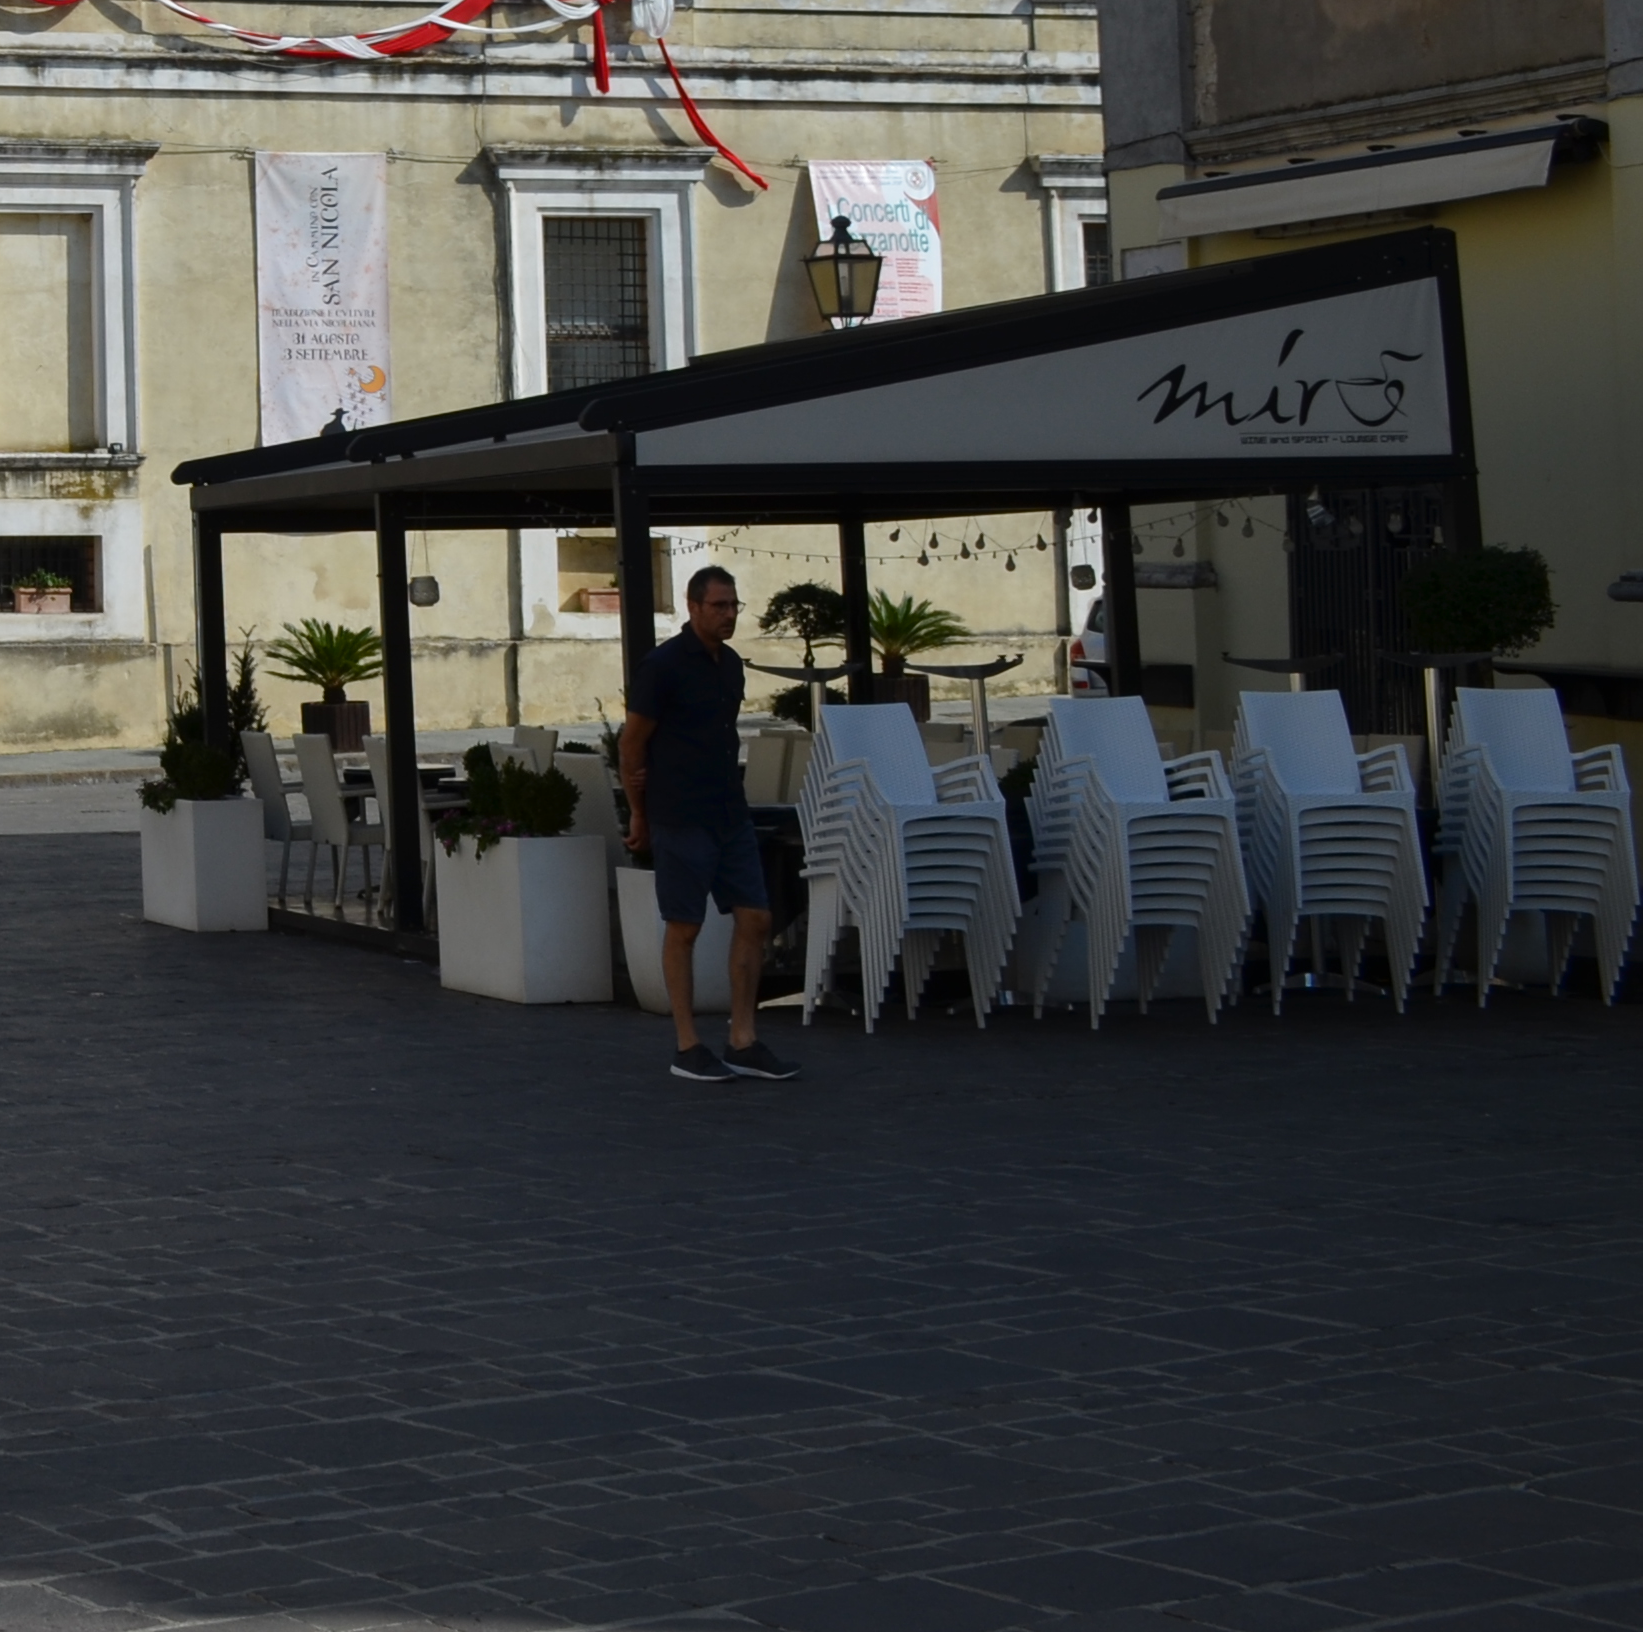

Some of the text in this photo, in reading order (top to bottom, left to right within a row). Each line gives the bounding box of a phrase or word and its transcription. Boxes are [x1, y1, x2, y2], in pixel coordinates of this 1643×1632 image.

[837, 197, 911, 223] Concerti
[915, 206, 930, 231] di
[320, 166, 341, 305] SAN NICOLA
[849, 229, 930, 253] ezzanotte
[311, 272, 320, 283] IN
[292, 333, 360, 345] 31 AGOSTO
[296, 348, 369, 361] SETTEMBRE
[1241, 436, 1267, 445] WINE
[1270, 435, 1290, 444] and
[1291, 435, 1329, 444] SPIRIT
[1340, 435, 1378, 444] LOUNGE
